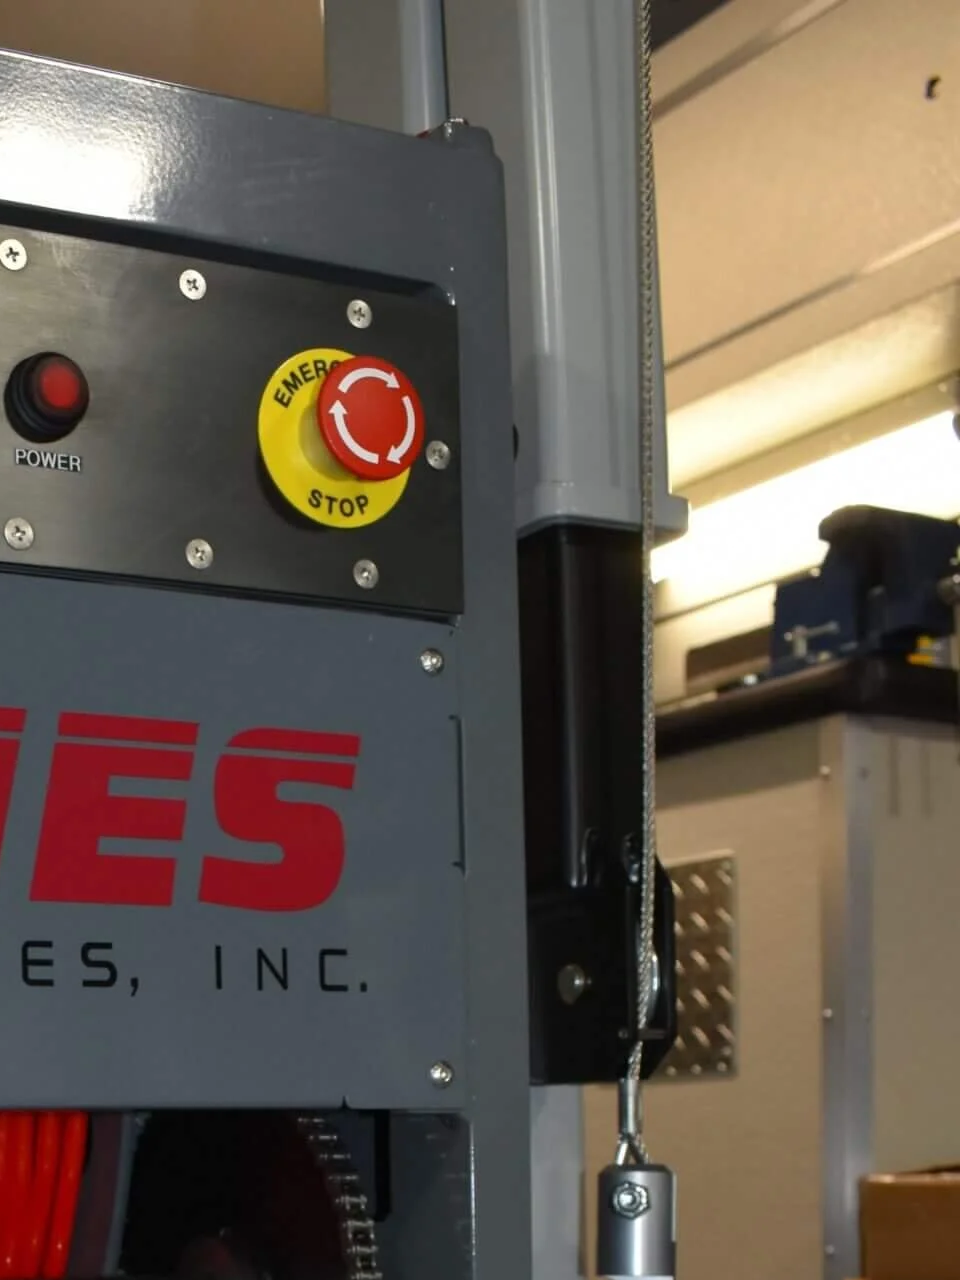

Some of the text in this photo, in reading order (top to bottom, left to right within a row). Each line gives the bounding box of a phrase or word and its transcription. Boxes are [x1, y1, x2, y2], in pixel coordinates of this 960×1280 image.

[14, 448, 82, 473] POWER
[307, 488, 370, 518] STOP
[214, 945, 370, 993] INC.
